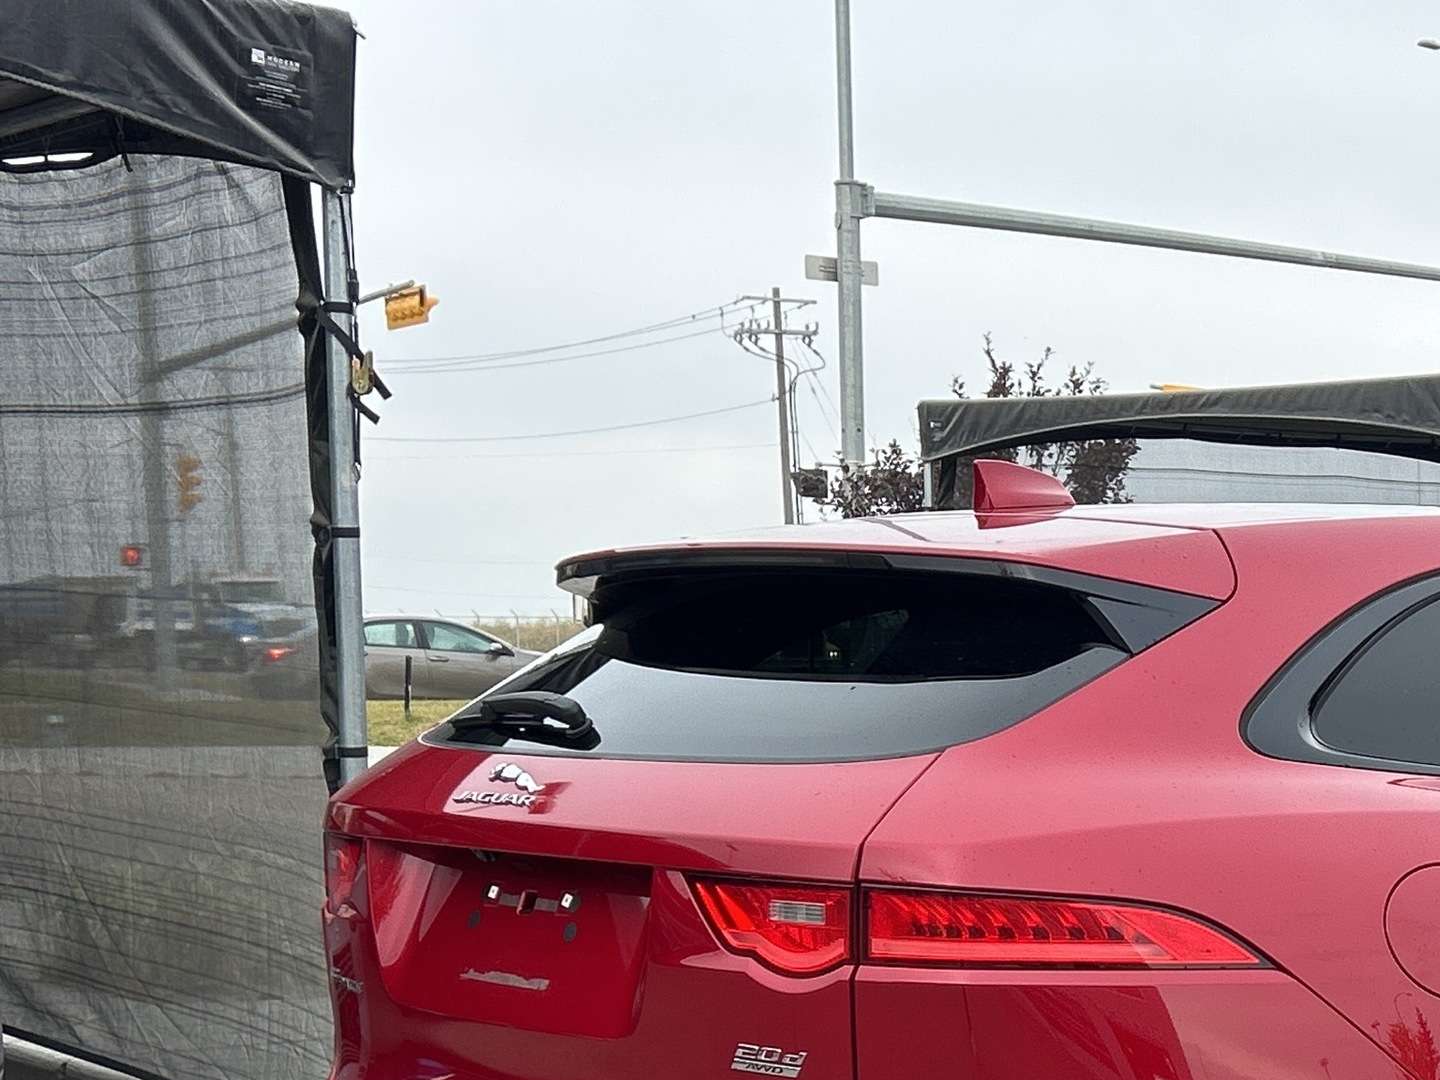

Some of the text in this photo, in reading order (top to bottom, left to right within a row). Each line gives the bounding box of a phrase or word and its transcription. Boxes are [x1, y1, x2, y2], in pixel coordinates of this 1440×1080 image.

[452, 791, 536, 807] JAGUAR
[735, 1043, 808, 1065] 20d
[745, 1063, 783, 1073] AWD
